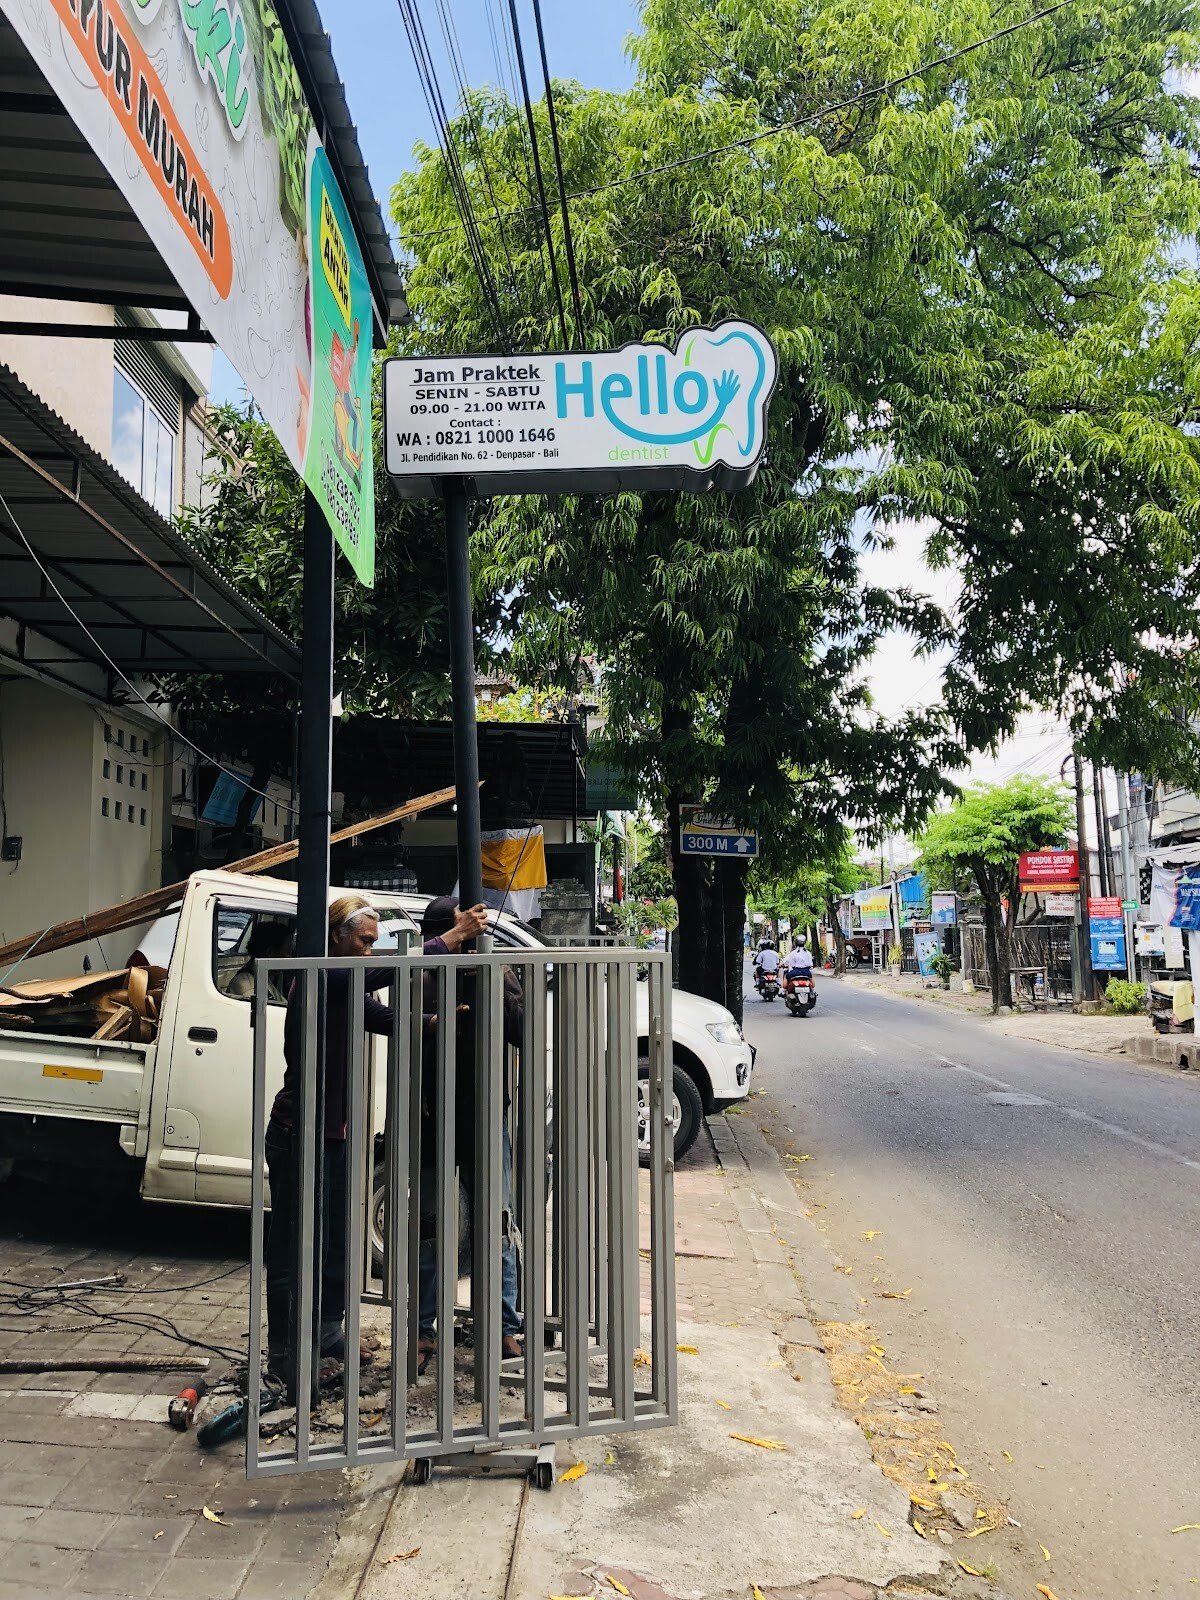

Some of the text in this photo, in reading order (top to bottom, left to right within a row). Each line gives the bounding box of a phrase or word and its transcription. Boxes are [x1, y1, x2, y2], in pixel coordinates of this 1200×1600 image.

[138, 74, 215, 259] MURAH
[324, 237, 348, 310] ANTAR
[413, 364, 541, 383] Jam Praktek
[415, 387, 469, 400] SENIN
[486, 385, 540, 398] SABTU
[555, 354, 715, 440] Hello
[410, 403, 450, 415] 09.00
[464, 402, 504, 413] 21.00
[508, 400, 546, 411] WITA
[449, 418, 495, 428] Contact
[396, 432, 423, 447] WA
[435, 430, 472, 446] 0821
[478, 429, 514, 444] 1000
[519, 428, 556, 443] 1646
[400, 453, 411, 463] Jl.
[413, 452, 459, 463] Pendidikan
[462, 451, 475, 461] No.
[478, 451, 488, 461] 62
[496, 450, 536, 461] Denpasar
[544, 448, 559, 459] Bali
[607, 444, 670, 461] dentist
[688, 836, 728, 851] 300 M
